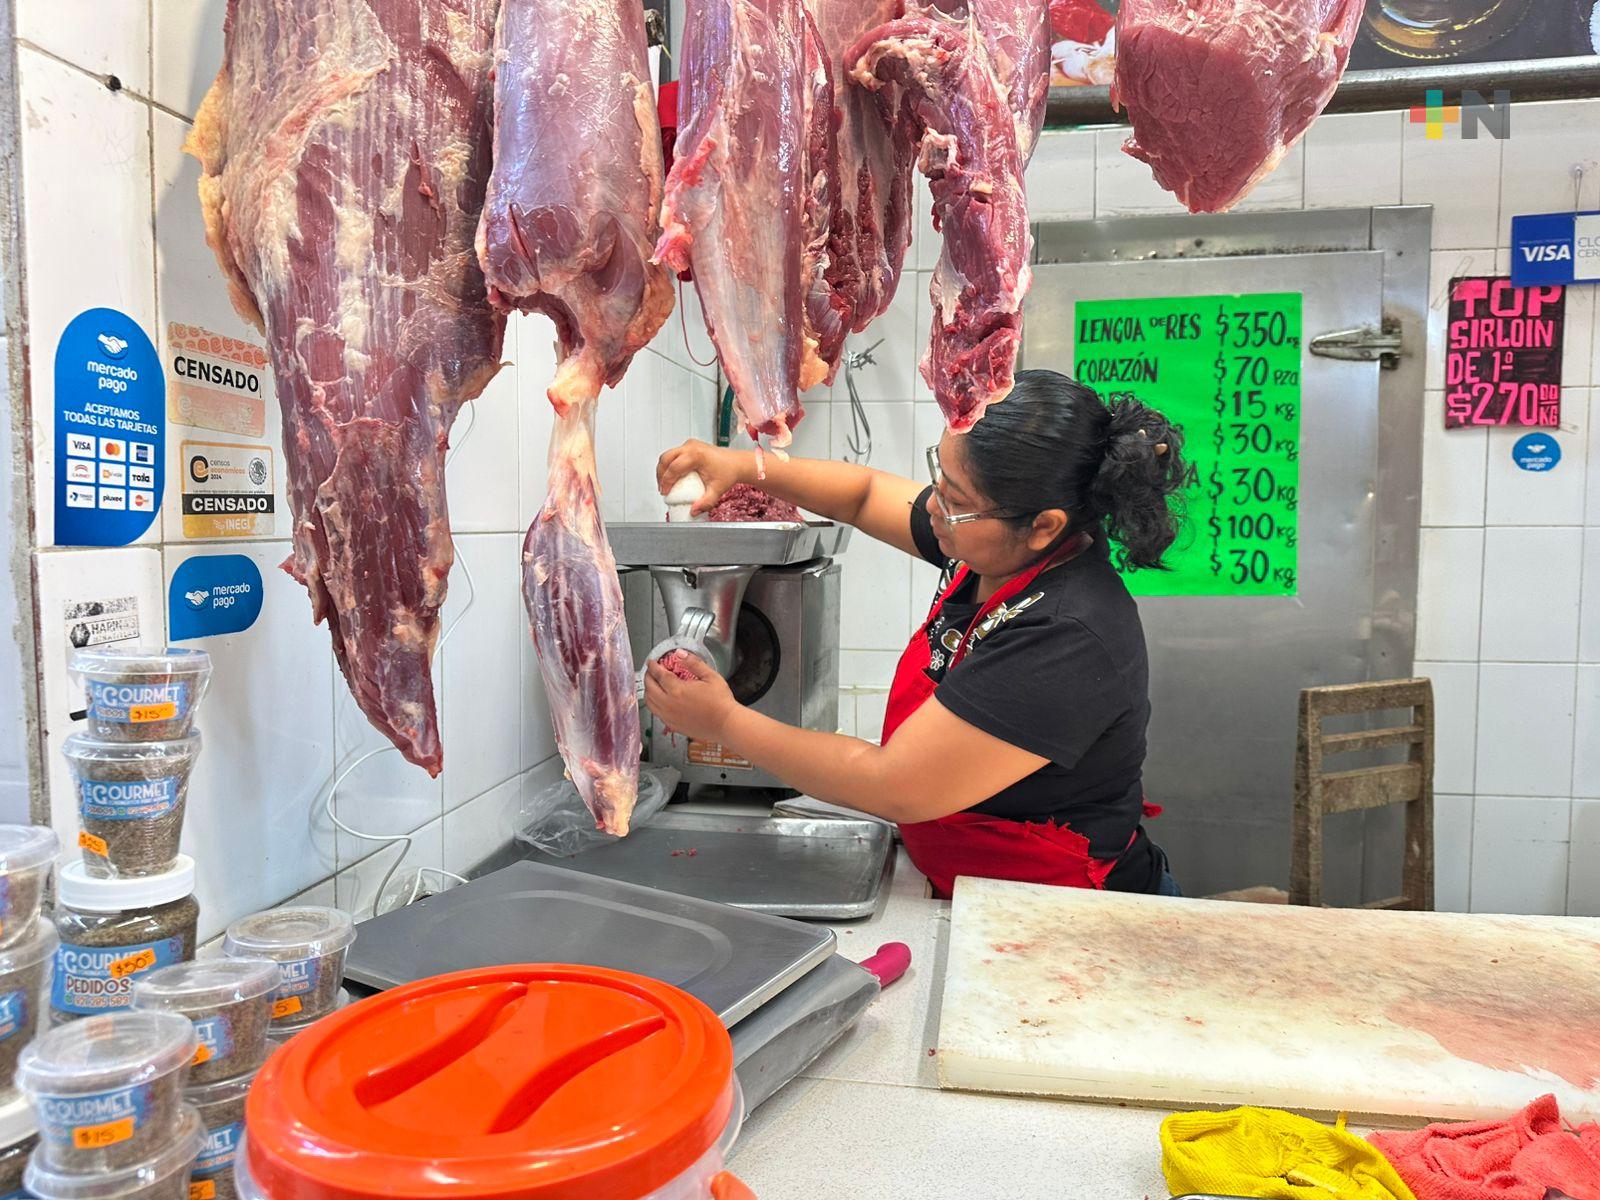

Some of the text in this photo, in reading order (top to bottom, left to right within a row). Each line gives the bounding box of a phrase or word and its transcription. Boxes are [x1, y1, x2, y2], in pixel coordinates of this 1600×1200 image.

[1520, 244, 1571, 262] VISA
[1453, 279, 1562, 318] TOP
[1165, 313, 1201, 340] RES
[1450, 319, 1554, 349] SIRLOIN
[87, 361, 138, 380] mercado
[174, 356, 259, 393] CENSADO
[1076, 352, 1158, 384] CORAZÓN
[1447, 352, 1481, 385] DE
[98, 377, 127, 393] pago
[84, 403, 141, 420] ACEPTAMOS
[1447, 383, 1538, 426] $270
[1539, 406, 1558, 425] KG
[63, 410, 158, 435] TODAS LAS TARJETAS
[73, 440, 91, 451] VISA
[191, 498, 268, 511] CENSADO
[212, 583, 251, 597] mercado
[212, 596, 236, 610] pago
[102, 686, 180, 707] GOURMET
[92, 781, 170, 805] GOURMET
